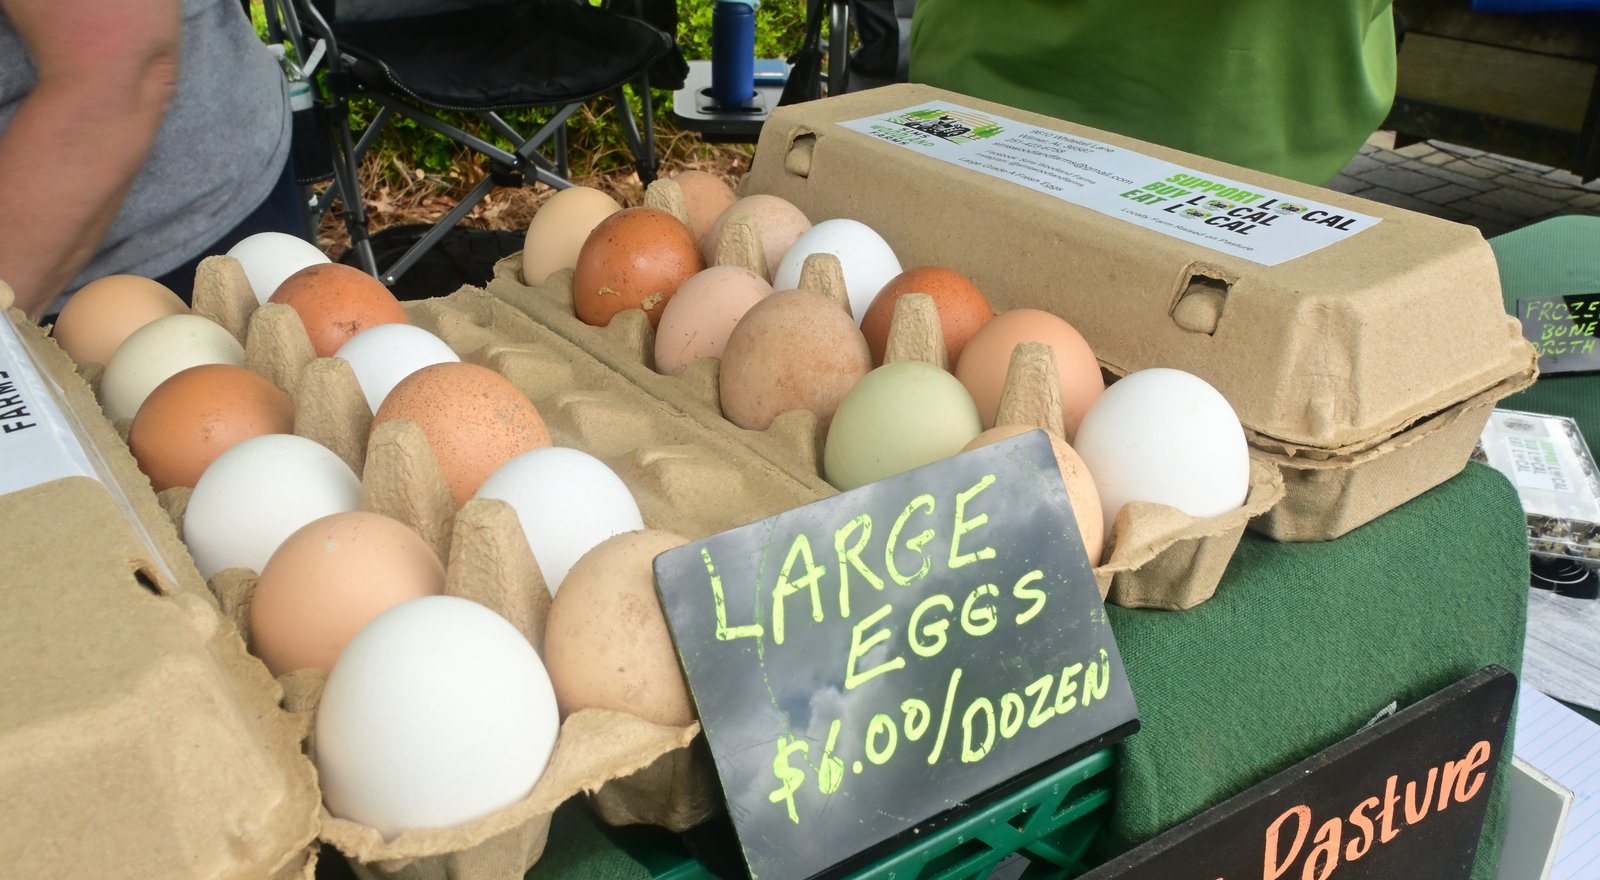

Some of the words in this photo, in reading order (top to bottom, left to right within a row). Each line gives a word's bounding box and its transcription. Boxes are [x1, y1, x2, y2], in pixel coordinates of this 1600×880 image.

[1091, 144, 1115, 153] Lane
[1039, 181, 1063, 192] Eggs
[1119, 189, 1168, 206] EAT
[1142, 181, 1192, 199] BUY
[1165, 173, 1265, 204] SUPPORT
[1121, 208, 1150, 219] Locally
[1151, 217, 1174, 227] Farm
[1174, 225, 1206, 236] Raised
[1219, 238, 1254, 251] Pasture
[1541, 321, 1598, 340] BONE
[701, 473, 996, 645] LARGE
[844, 570, 1047, 690] EGGS
[1263, 740, 1491, 880] Pasture
